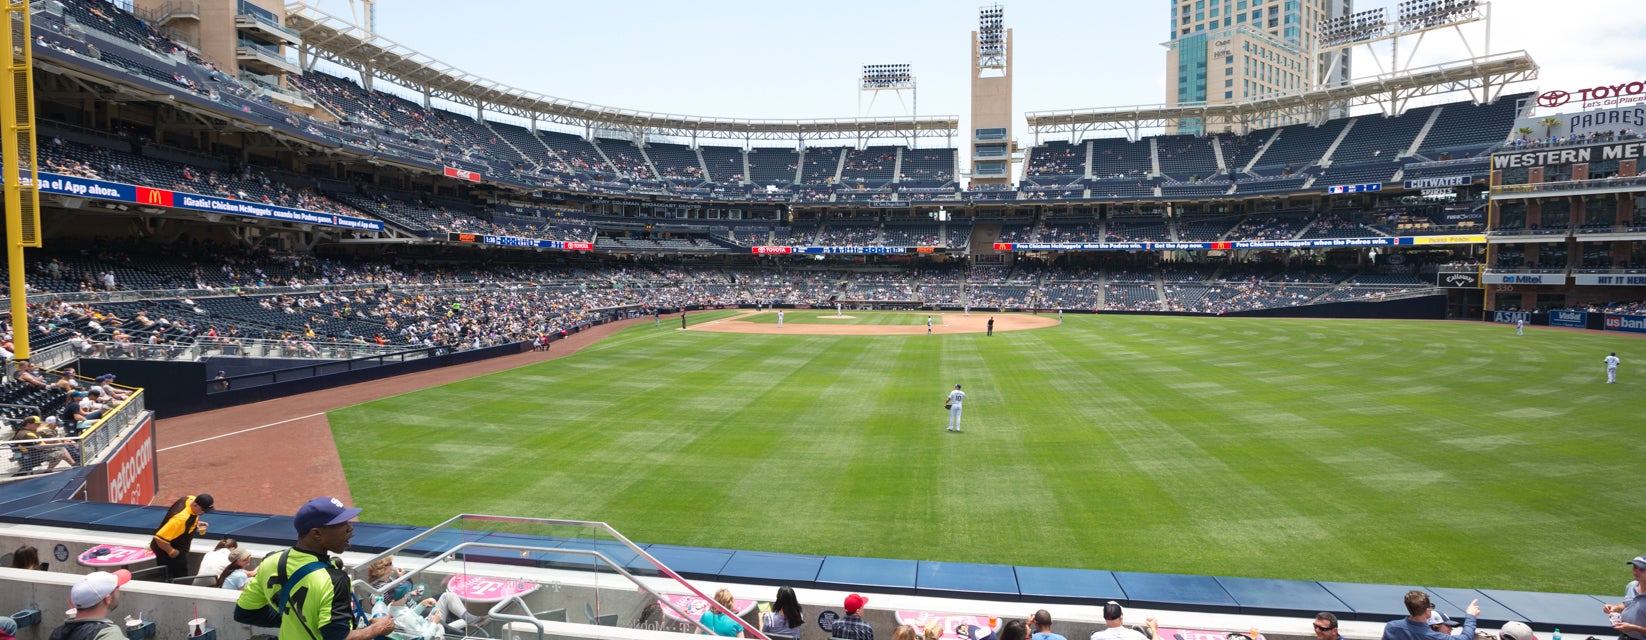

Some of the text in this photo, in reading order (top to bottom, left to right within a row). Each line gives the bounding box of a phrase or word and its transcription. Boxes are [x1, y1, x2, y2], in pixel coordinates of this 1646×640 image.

[1578, 81, 1646, 101] TOYO
[1620, 96, 1646, 104] Place
[1570, 108, 1644, 133] PADRES
[1494, 148, 1591, 168] WESTERN
[52, 180, 62, 190] el
[64, 182, 87, 195] App
[88, 184, 120, 197] ahora.
[1411, 177, 1463, 188] CUTWATER
[211, 200, 239, 212] Chicken
[301, 212, 318, 222] Padres
[1445, 273, 1475, 283] Callaway
[1516, 275, 1542, 284] Mitel
[1598, 276, 1613, 284] HIT
[1615, 276, 1625, 284] IT
[1495, 311, 1530, 324] ASML
[110, 436, 153, 504] petco.com
